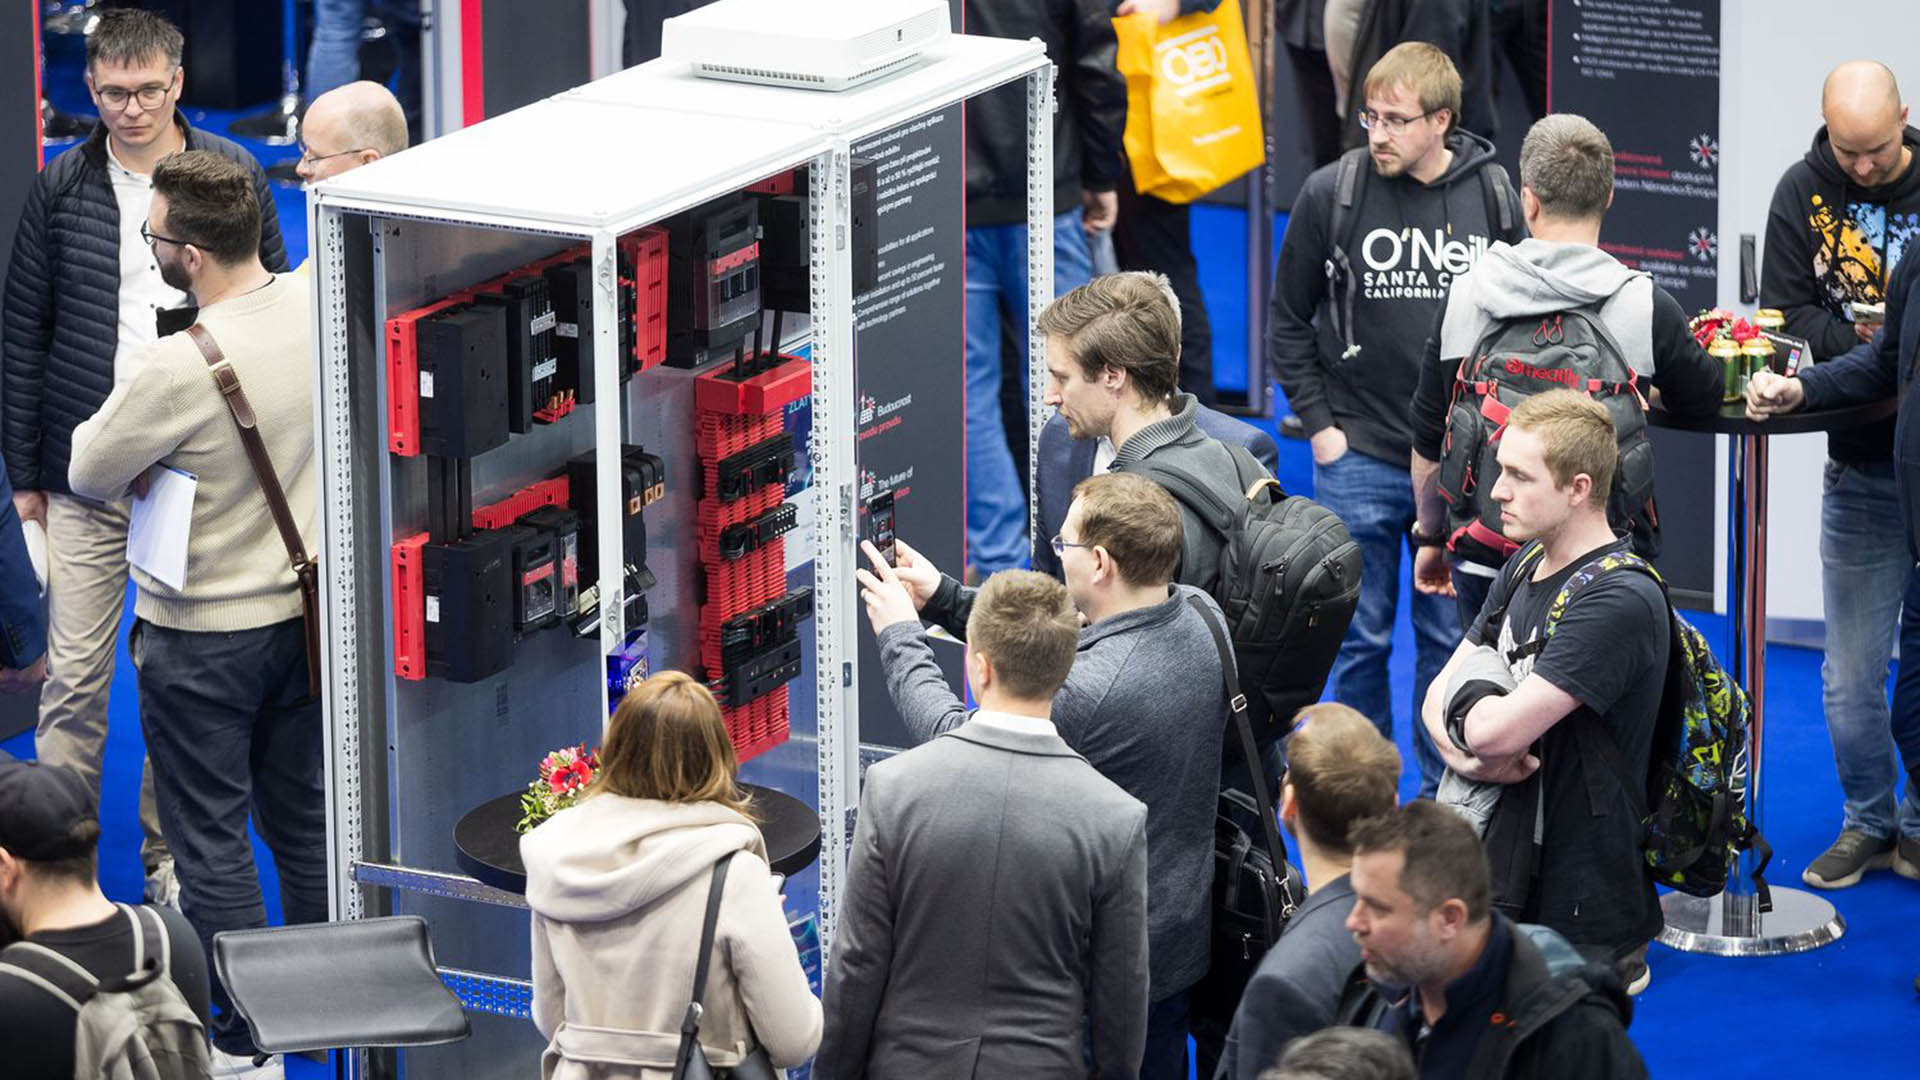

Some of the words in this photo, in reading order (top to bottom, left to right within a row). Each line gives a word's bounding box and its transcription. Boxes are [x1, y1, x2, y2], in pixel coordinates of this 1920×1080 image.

[1364, 271, 1429, 287] SANTA
[1438, 272, 1450, 288] C
[1654, 274, 1686, 288] Europe
[1364, 288, 1445, 299] CALIFORNIA
[879, 479, 889, 490] The
